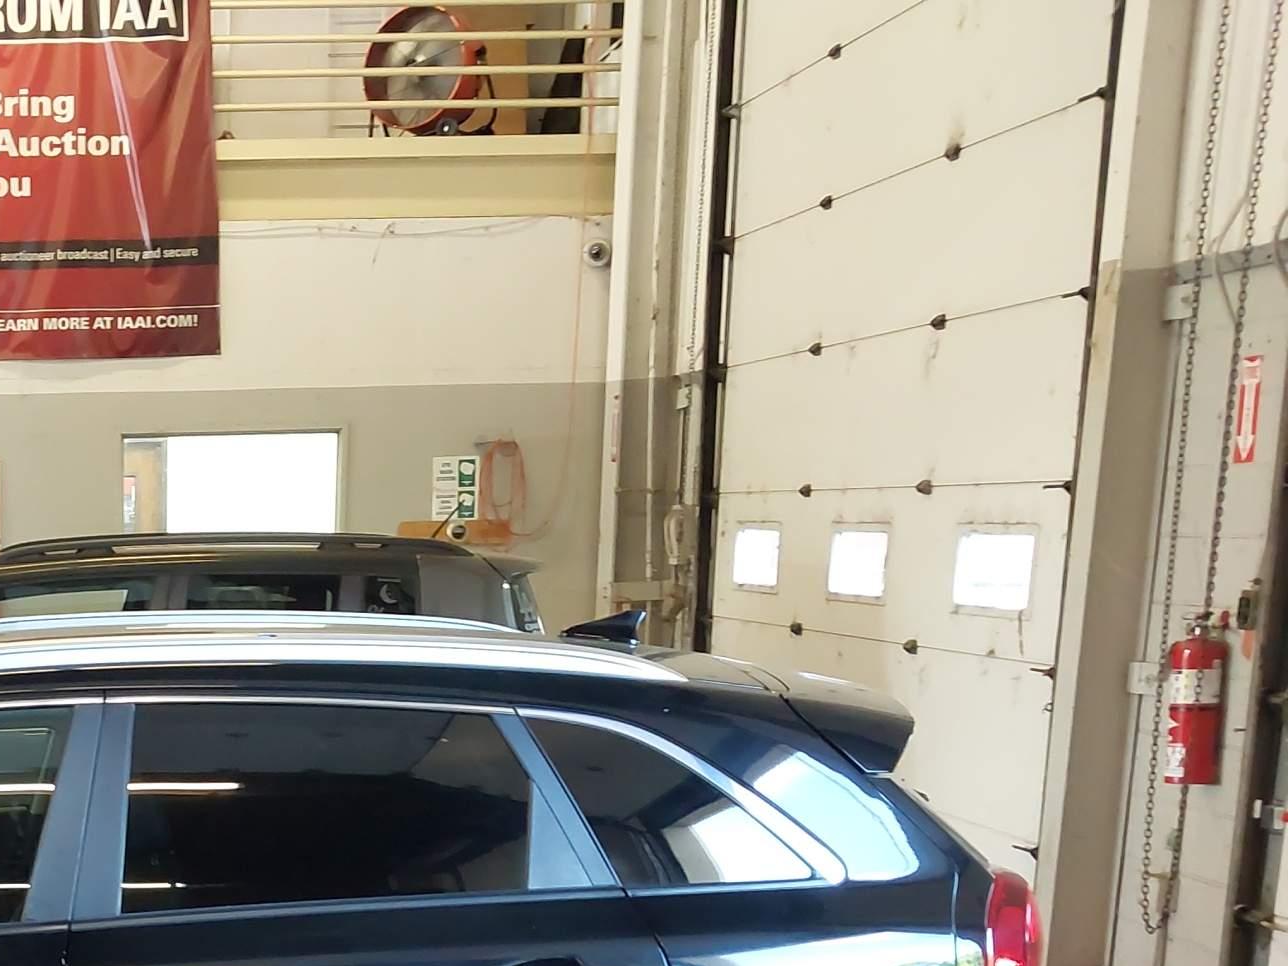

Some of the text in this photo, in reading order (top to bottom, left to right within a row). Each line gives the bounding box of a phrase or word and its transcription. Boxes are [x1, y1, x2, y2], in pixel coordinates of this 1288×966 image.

[99, 0, 177, 30] IAA
[0, 250, 55, 262] auctioneer
[56, 249, 110, 261] broadcast
[115, 248, 140, 262] Easy
[141, 247, 161, 260] and
[162, 247, 199, 259] secure
[42, 316, 90, 331] MORE
[92, 316, 114, 330] AT
[116, 314, 199, 330] IAAI.COM!
